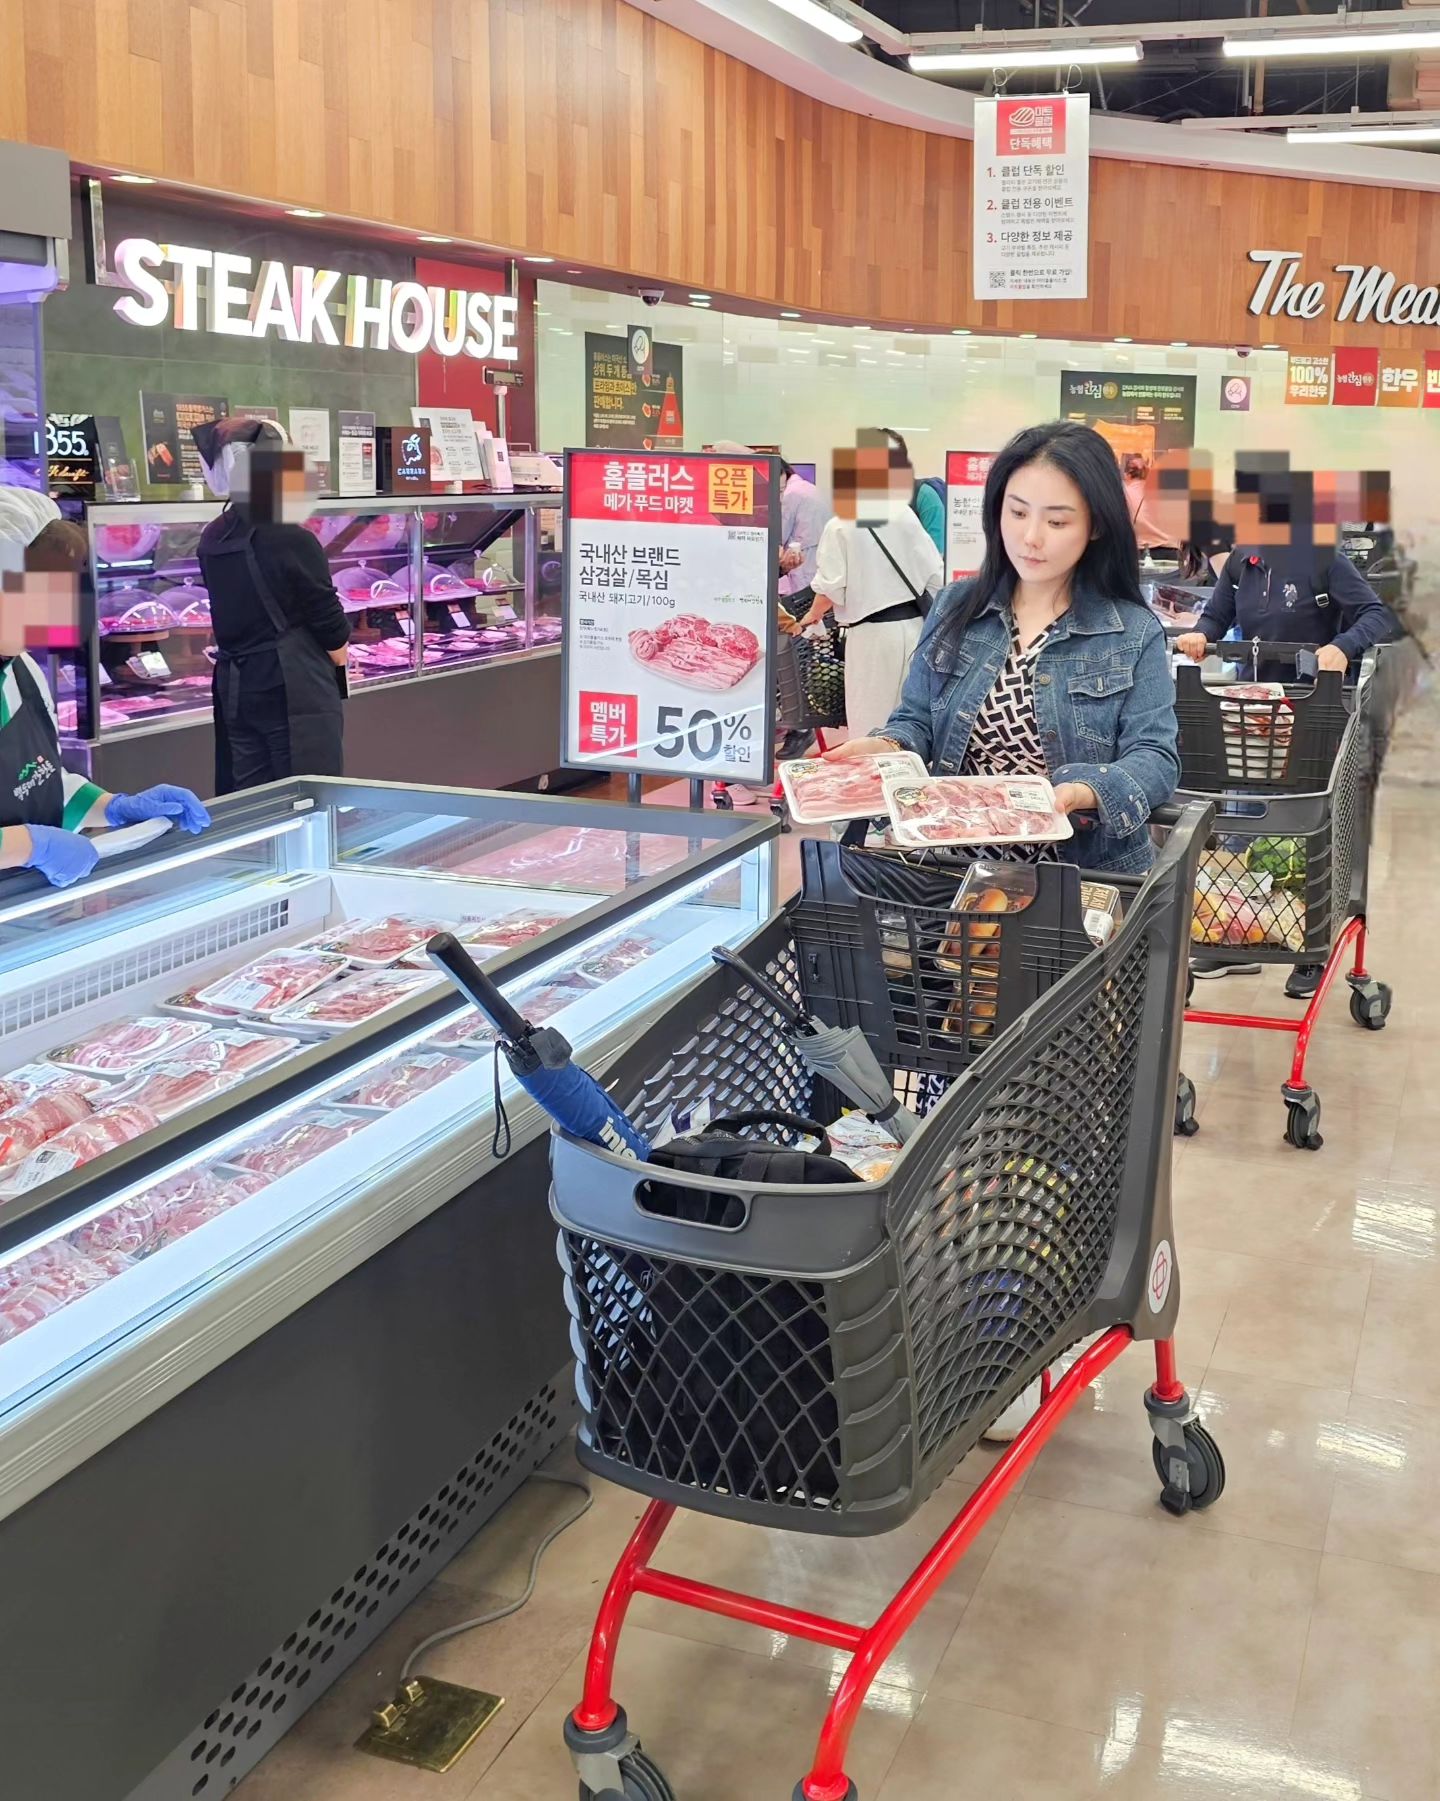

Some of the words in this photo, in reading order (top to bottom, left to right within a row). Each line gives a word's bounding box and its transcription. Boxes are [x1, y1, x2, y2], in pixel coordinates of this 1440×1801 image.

[987, 167, 996, 177] 1.
[1001, 166, 1020, 177] 클럽
[1023, 165, 1043, 177] 단독
[1045, 164, 1065, 176] 할인
[987, 199, 997, 210] 2.
[1001, 198, 1020, 210] 클럽
[1023, 198, 1042, 209] 전용
[1044, 197, 1074, 208] 이벤트
[987, 232, 997, 243] 3.
[1001, 231, 1029, 242] 다양한
[1032, 231, 1051, 242] 정보
[1054, 230, 1072, 241] 제공
[1247, 250, 1326, 320] The
[113, 238, 340, 345] STEAK
[344, 273, 518, 361] HOUSE
[1290, 366, 1328, 385] 100%
[1382, 367, 1418, 393] 한우
[602, 461, 694, 492] 홈플러스
[713, 467, 748, 488] 오픈
[604, 493, 633, 512] 메가
[634, 494, 664, 512] 푸드
[665, 496, 694, 514] 마켓
[712, 490, 748, 511] 특가
[579, 543, 627, 565] 국내산
[631, 546, 681, 567] 브랜드
[579, 566, 669, 591] 삼겹살/목심
[579, 590, 606, 604] 국내산
[590, 701, 626, 725] 멤버
[590, 725, 627, 748] 특가
[653, 705, 752, 762] 50%
[723, 744, 751, 763] 할인
[599, 1116, 638, 1160] inte
